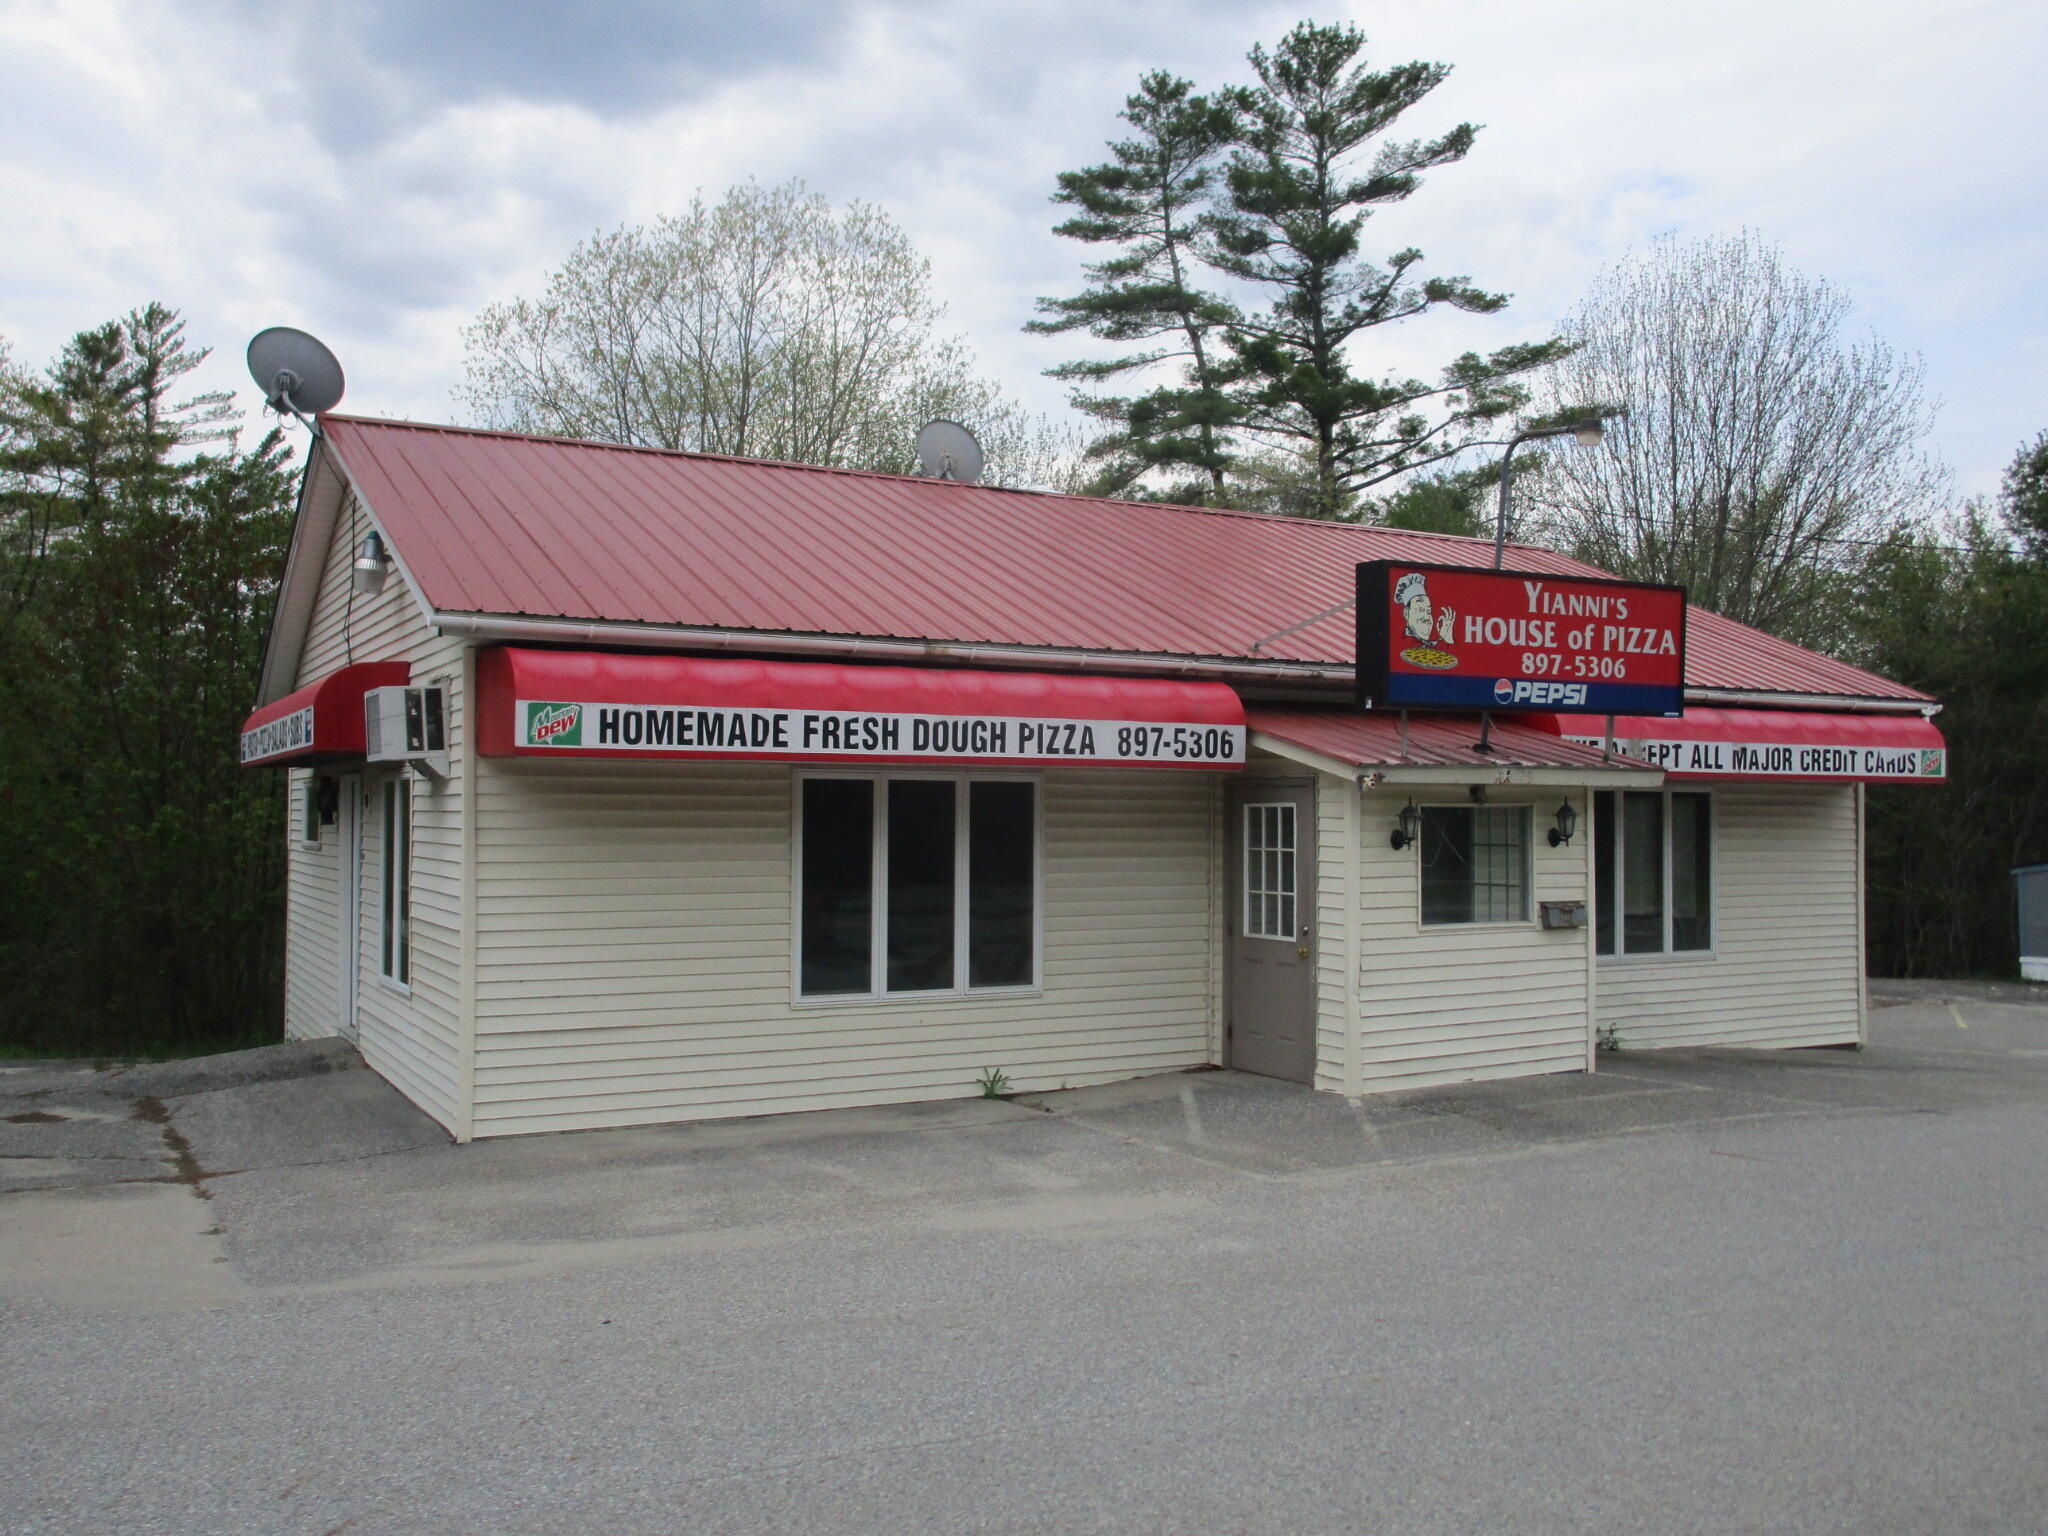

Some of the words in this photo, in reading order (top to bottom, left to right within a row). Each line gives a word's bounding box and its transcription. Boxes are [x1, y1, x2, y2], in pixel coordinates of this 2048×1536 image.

[1464, 615, 1558, 648] HOUSE
[1567, 624, 1595, 650] of
[1603, 625, 1676, 655] PIZZA
[1521, 652, 1626, 678] 897-5306
[1514, 681, 1588, 705] PEPSI
[599, 708, 789, 749] HOMEMADE
[803, 714, 899, 751] FRESH
[912, 718, 1007, 754] DOUGH
[1018, 722, 1096, 756] PIZZA
[1117, 726, 1234, 759] 897-5306
[1690, 744, 1724, 770] ALL
[1732, 746, 1793, 772] MAJOR
[1800, 748, 1858, 773] CREDIT
